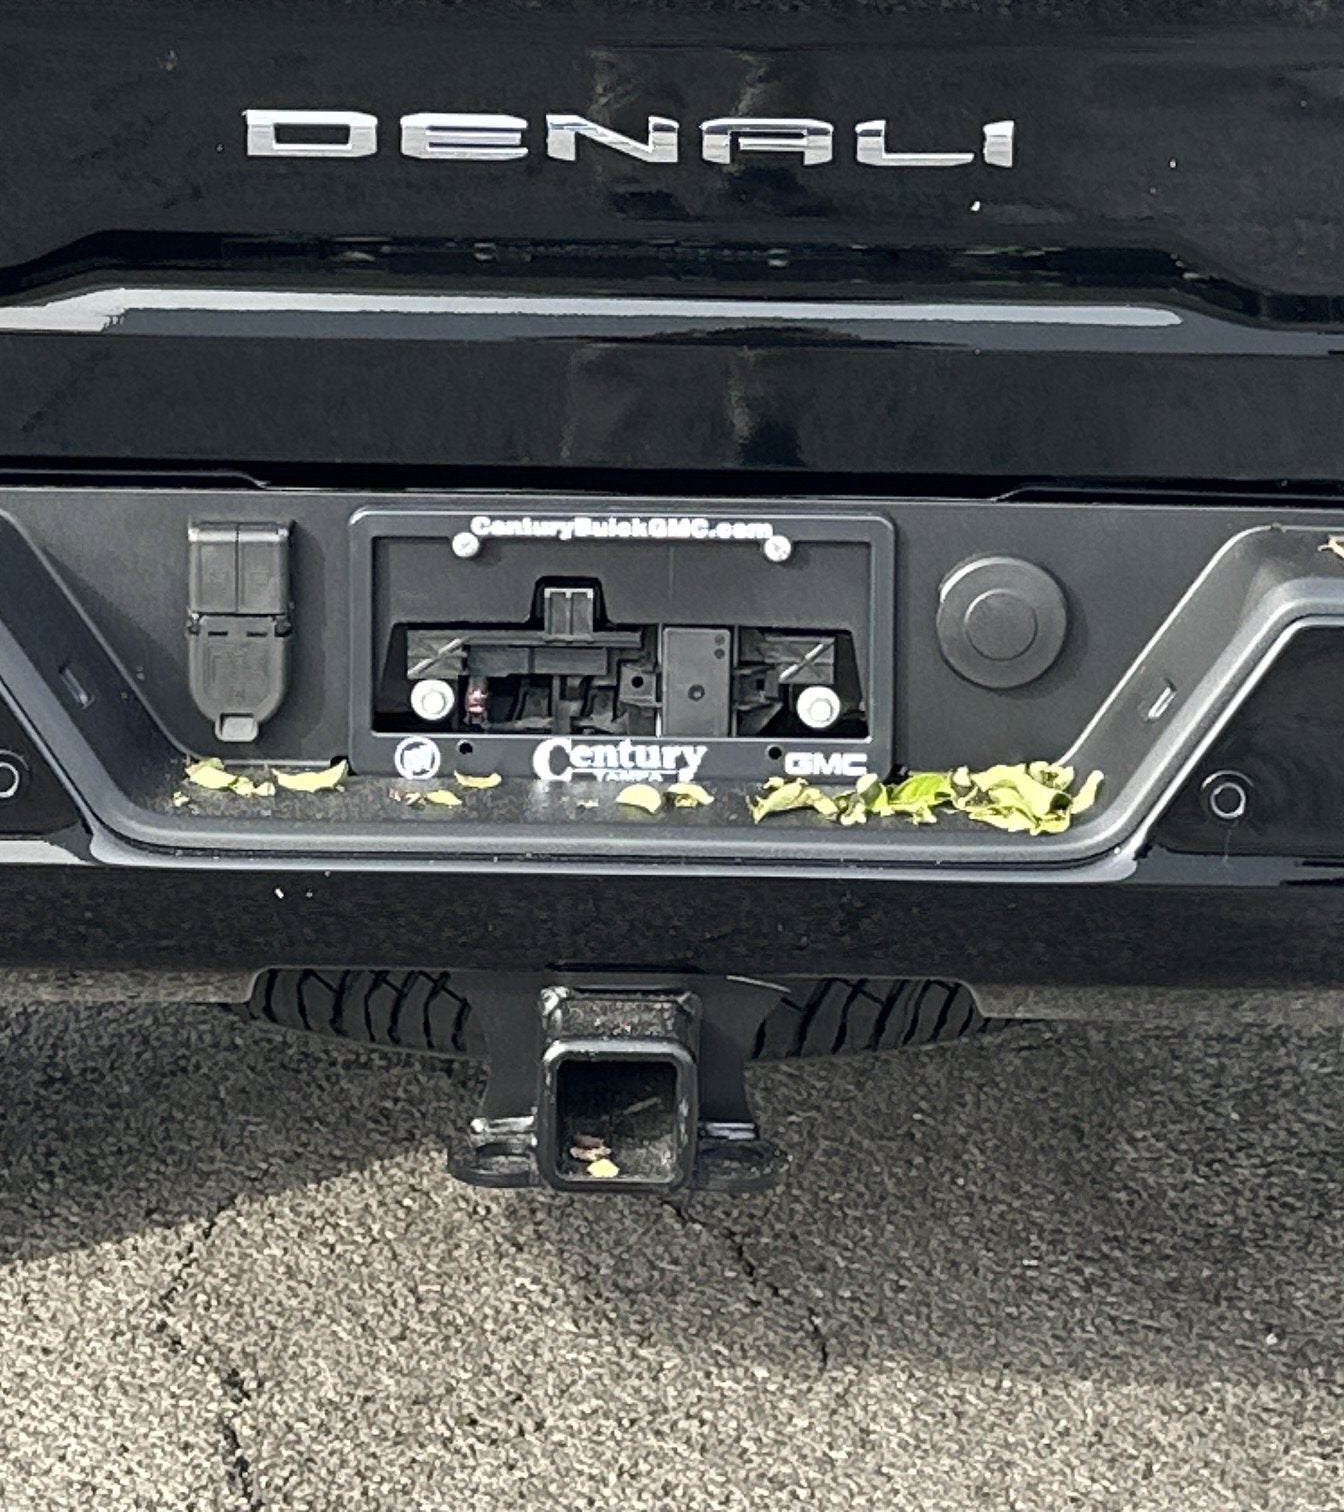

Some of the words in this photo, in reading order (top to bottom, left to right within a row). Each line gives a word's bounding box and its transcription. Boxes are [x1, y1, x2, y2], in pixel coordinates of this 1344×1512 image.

[243, 108, 1015, 169] DENALI
[470, 515, 773, 540] CenturyBuickGMC.com
[533, 737, 708, 782] Century
[784, 752, 868, 776] GMC
